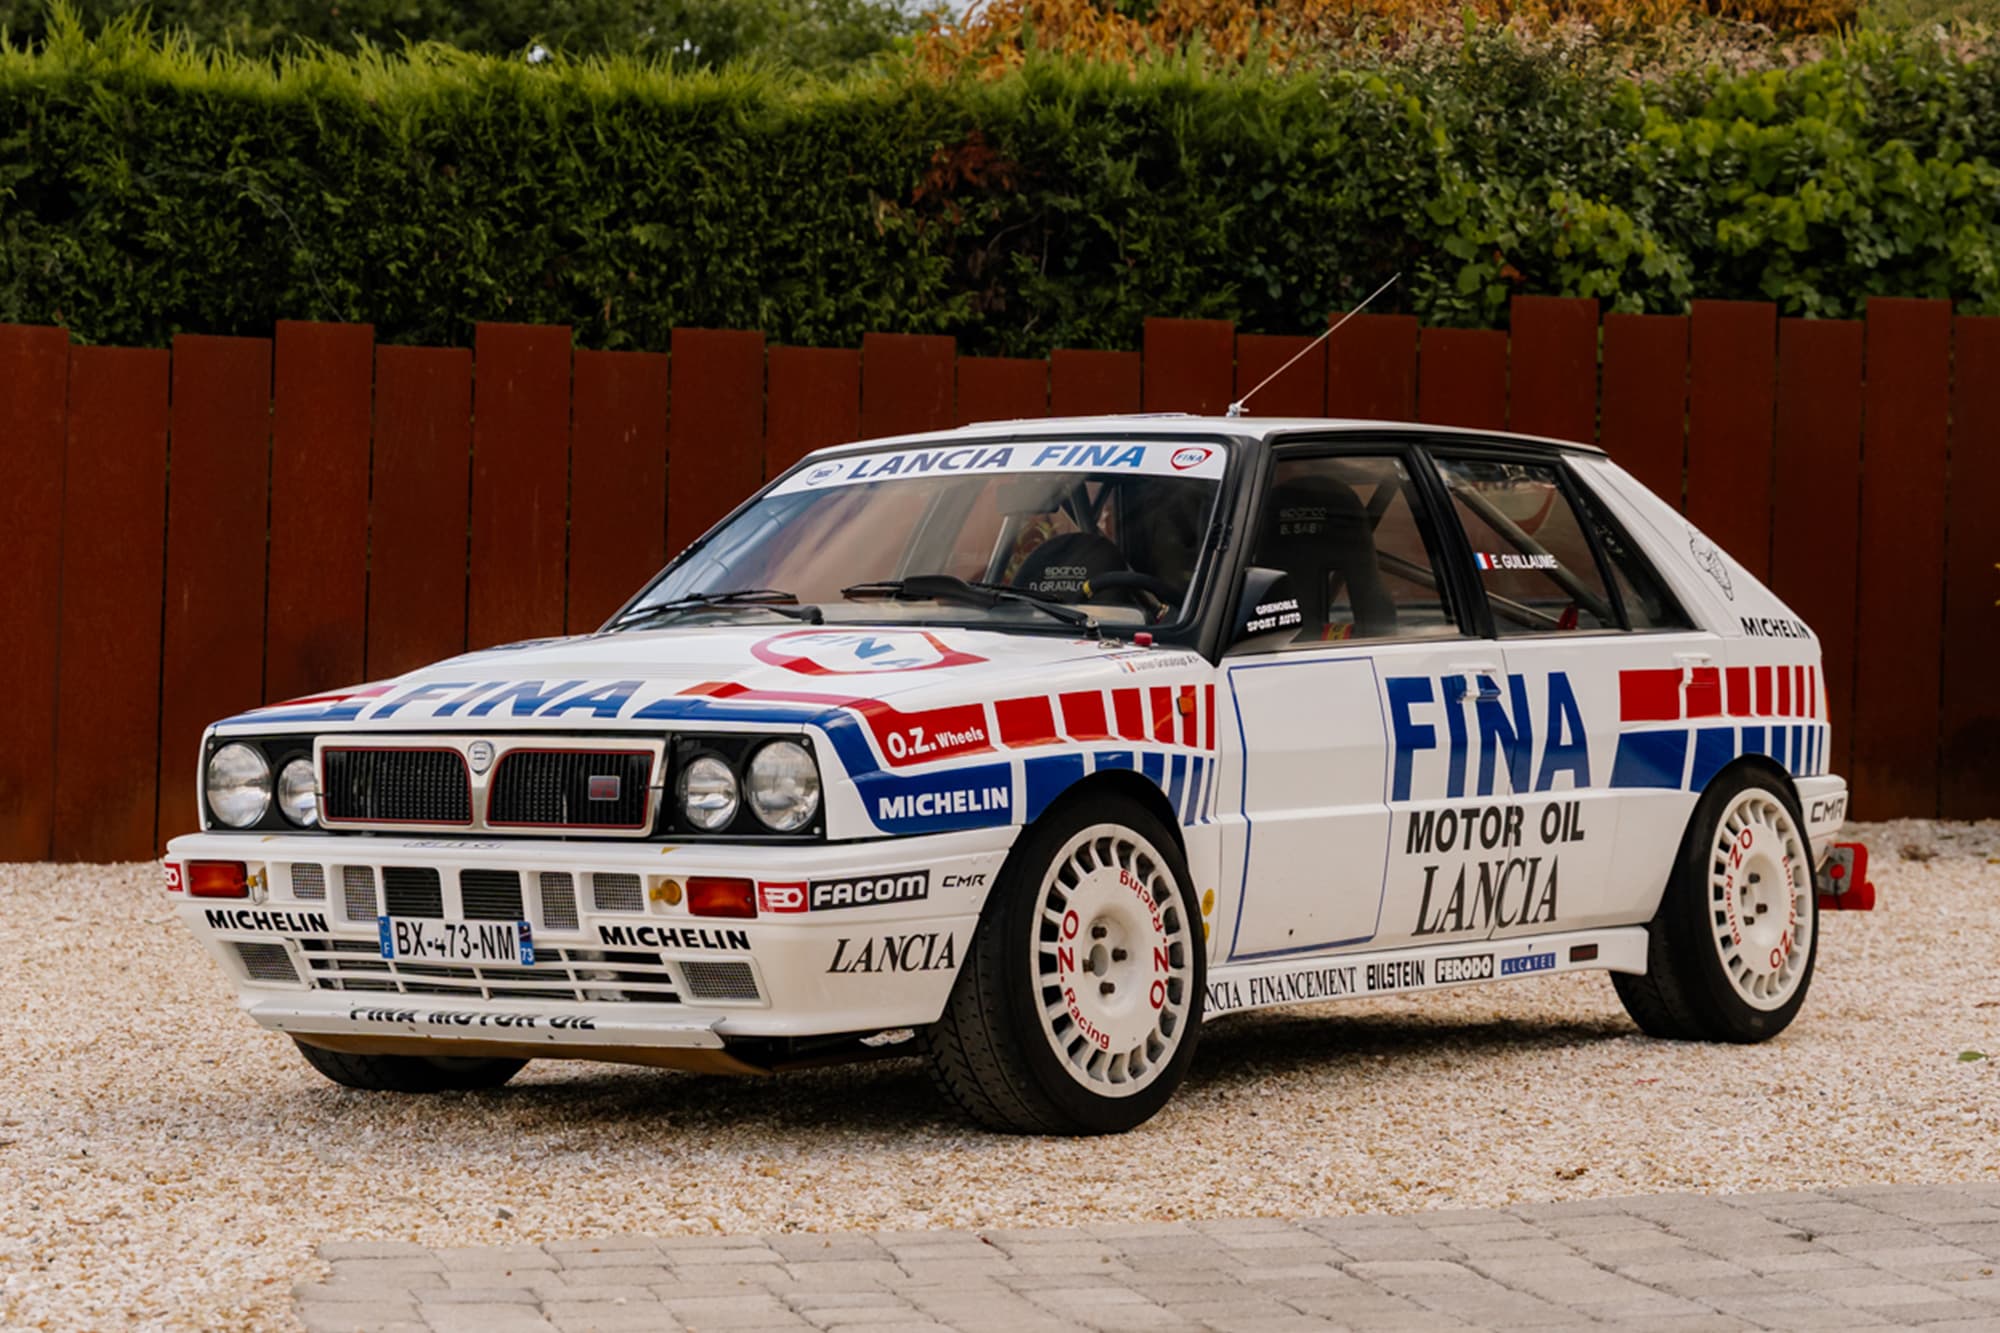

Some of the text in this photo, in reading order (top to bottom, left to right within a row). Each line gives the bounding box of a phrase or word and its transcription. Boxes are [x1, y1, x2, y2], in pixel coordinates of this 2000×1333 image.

[846, 446, 1147, 480] LANCIA FINA
[1176, 453, 1203, 462] FINA
[1490, 554, 1558, 569] E. GUILLAUME
[1246, 612, 1302, 632] SPORT AUTO
[1255, 599, 1299, 616] GRENOBLE
[1740, 616, 1811, 639] MICHELIN
[369, 680, 646, 719] FINA
[887, 726, 985, 759] O.Z. Wheels
[1385, 671, 1591, 802] FINA
[879, 786, 1009, 820] MICHELIN
[1406, 801, 1585, 855] MOTOR OIL
[813, 875, 926, 907] FACOM
[942, 873, 987, 888] CMR
[1410, 854, 1559, 936] LANCIA
[205, 909, 329, 933] MICHELIN
[396, 921, 516, 961] BX-473-NM
[598, 925, 751, 951] MICHELIN
[825, 931, 956, 974] LANCIA
[520, 948, 535, 962] 73
[1249, 966, 1357, 1005] FINANCEMENT
[1367, 960, 1425, 990] BILSTEIN
[1437, 956, 1492, 982] FERODO
[1503, 953, 1554, 973] ALCATEL
[1064, 987, 1111, 1050] Racing
